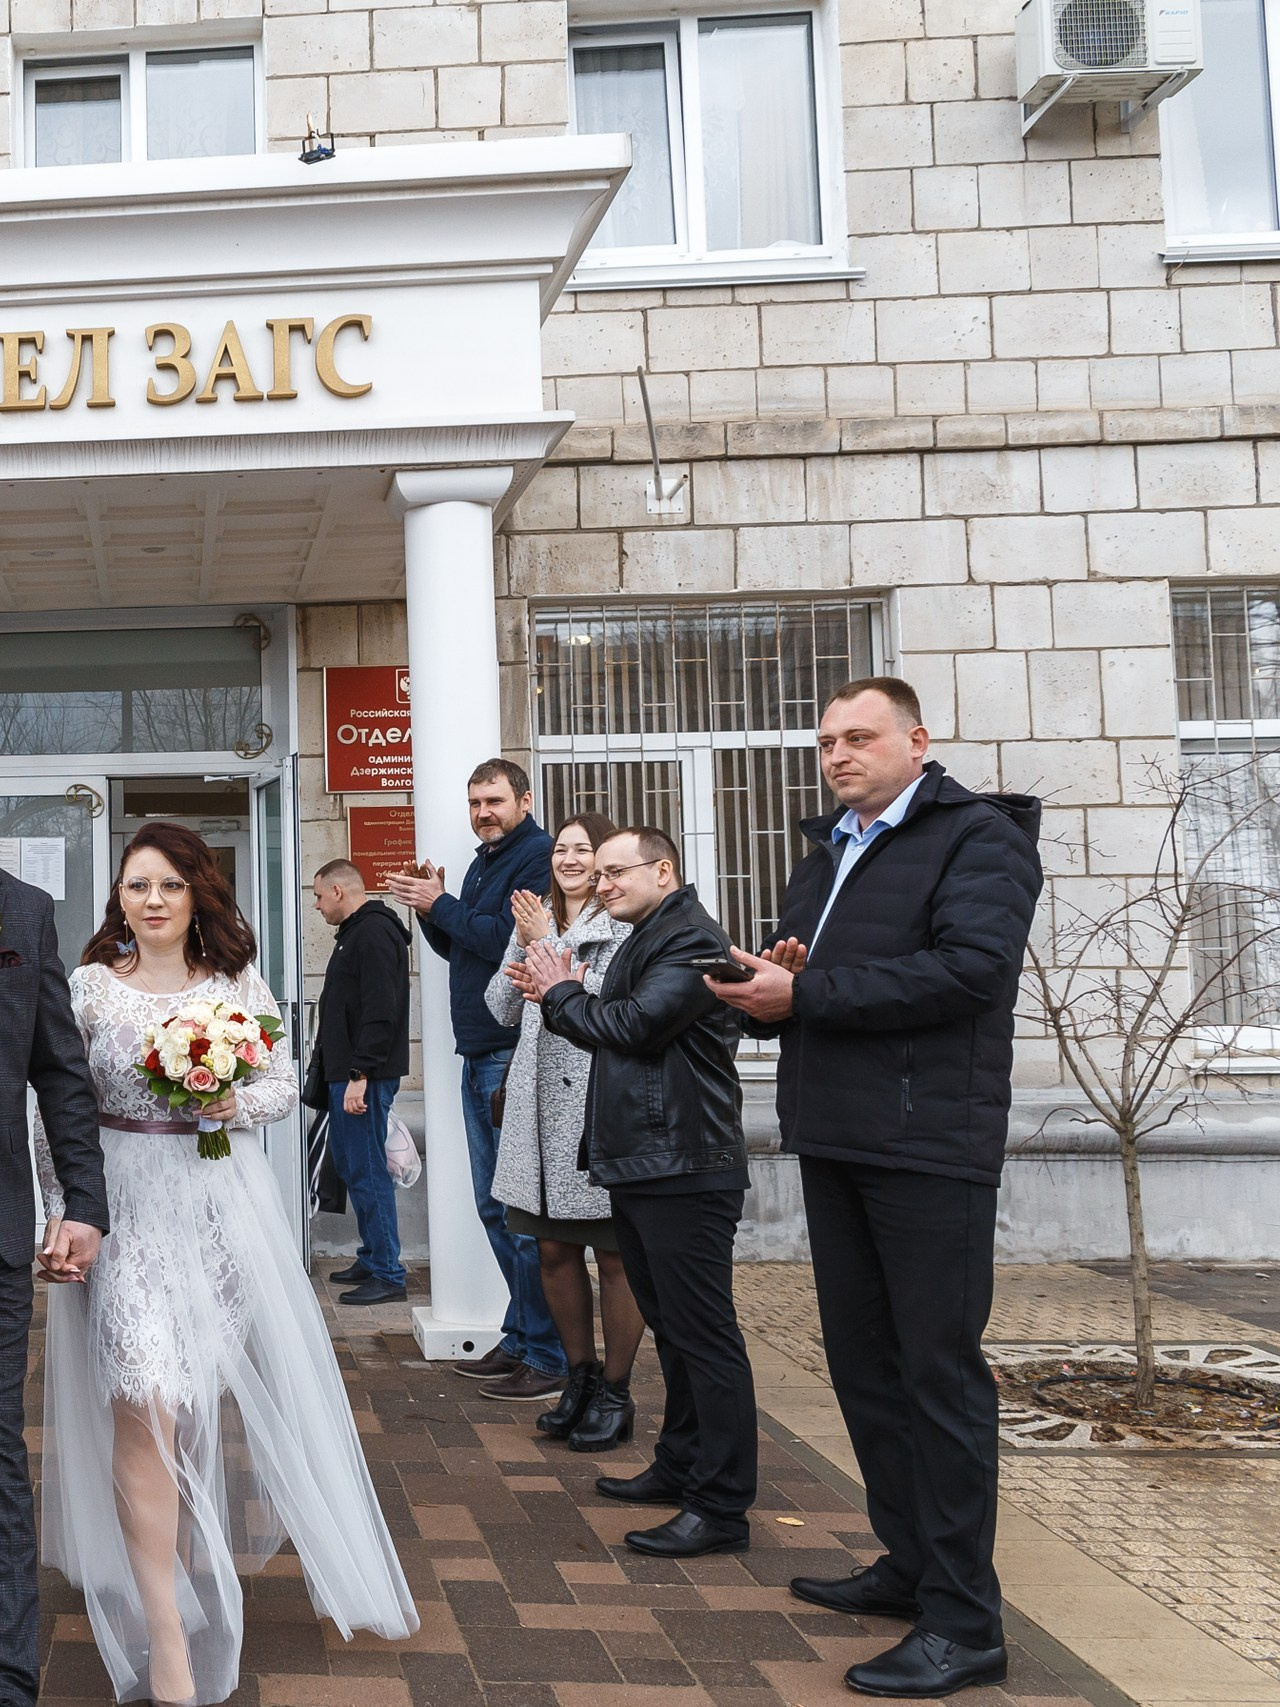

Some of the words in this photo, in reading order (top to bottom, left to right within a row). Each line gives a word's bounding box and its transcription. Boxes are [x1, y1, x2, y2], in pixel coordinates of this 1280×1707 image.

[144, 314, 374, 405] ЗАГС
[337, 724, 413, 747] Отдел
[368, 755, 413, 764] админи
[381, 778, 414, 787] Волго
[384, 839, 413, 847] График
